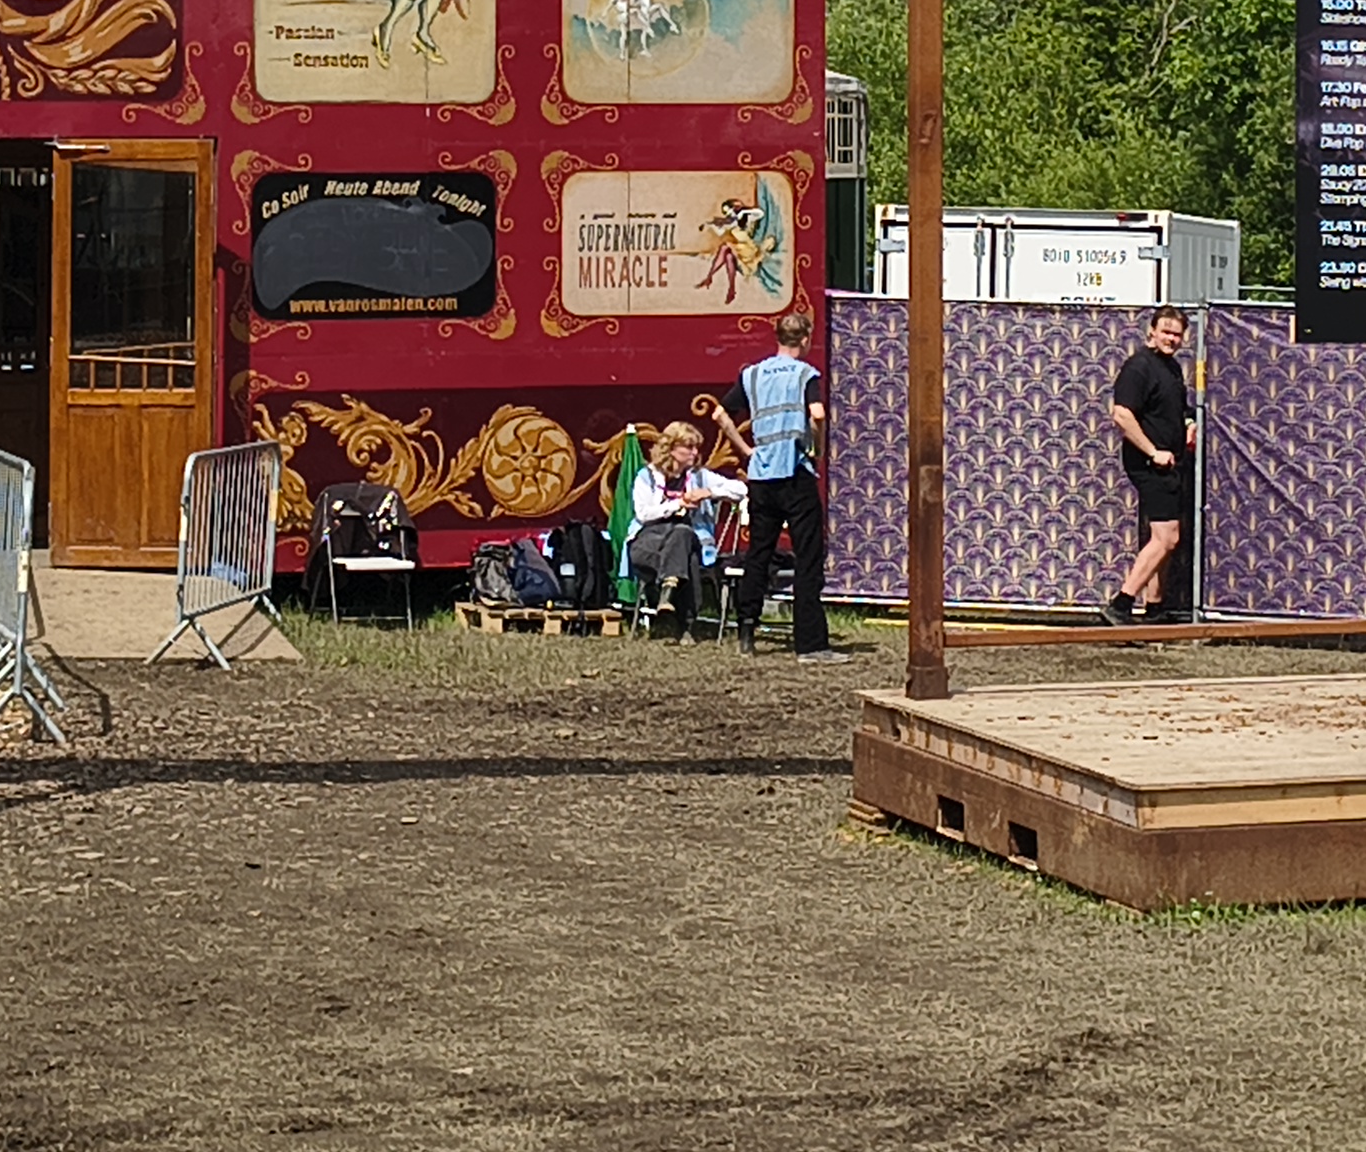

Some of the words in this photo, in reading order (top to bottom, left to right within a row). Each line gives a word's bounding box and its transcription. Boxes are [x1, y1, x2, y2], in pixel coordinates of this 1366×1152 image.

[293, 52, 369, 68] Sensation
[432, 184, 486, 217] Tonight
[578, 223, 676, 252] SUPERNATURAL
[579, 255, 668, 288] MIRACLE
[289, 297, 458, 314] www.vanrosmalen.com
